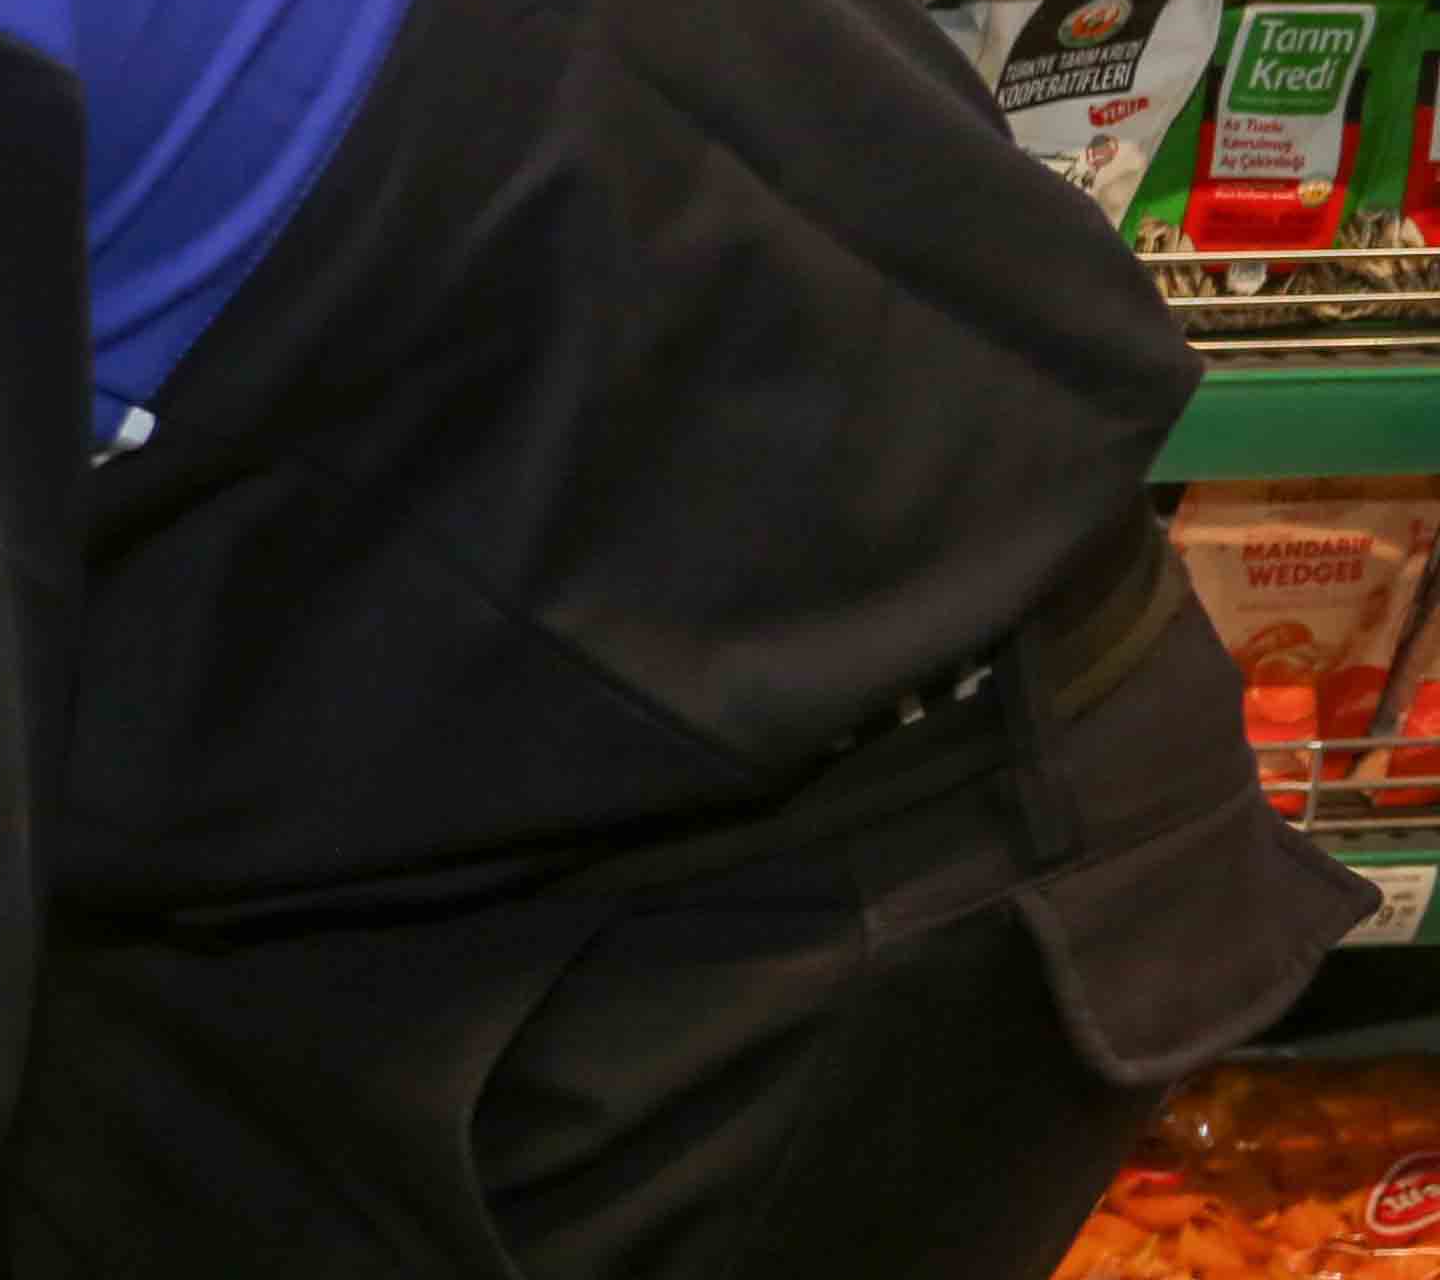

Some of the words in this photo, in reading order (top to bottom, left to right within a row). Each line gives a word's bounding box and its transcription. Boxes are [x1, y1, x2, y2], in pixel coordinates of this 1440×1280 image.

[1260, 19, 1354, 54] Tarım
[997, 63, 1134, 106] KOOPERATİFLERİ
[1249, 57, 1337, 92] Kredi
[1247, 560, 1364, 588] WEDGES
